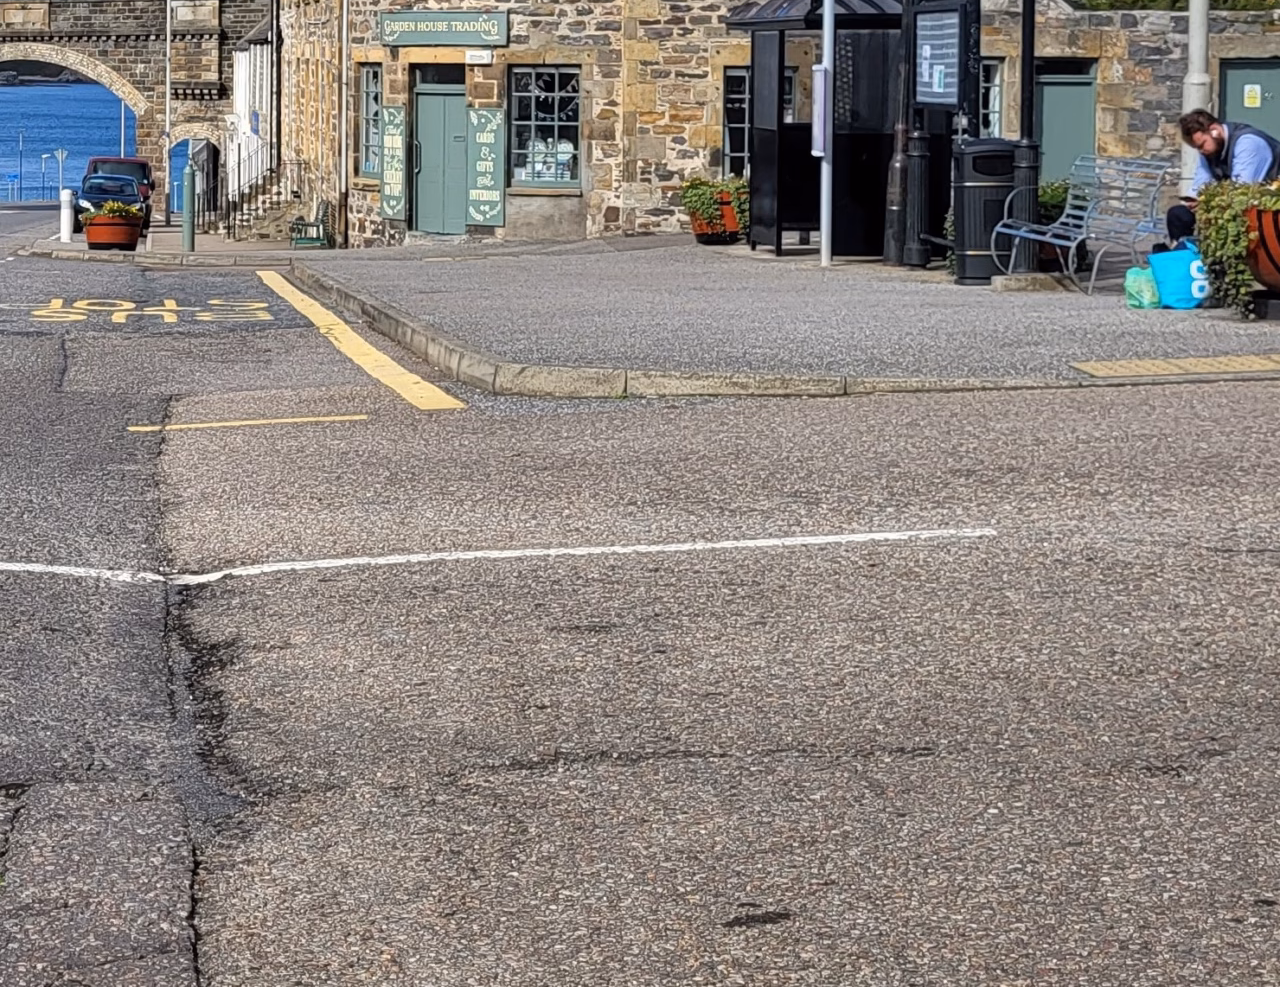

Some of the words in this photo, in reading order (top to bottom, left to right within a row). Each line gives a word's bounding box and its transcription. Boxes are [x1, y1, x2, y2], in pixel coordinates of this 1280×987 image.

[384, 20, 415, 34] GARDEN
[417, 21, 449, 32] HOUSE
[450, 19, 498, 34] TRADING
[476, 132, 495, 143] CARDS
[476, 161, 494, 172] GIFTS
[469, 190, 501, 201] INTERIORS
